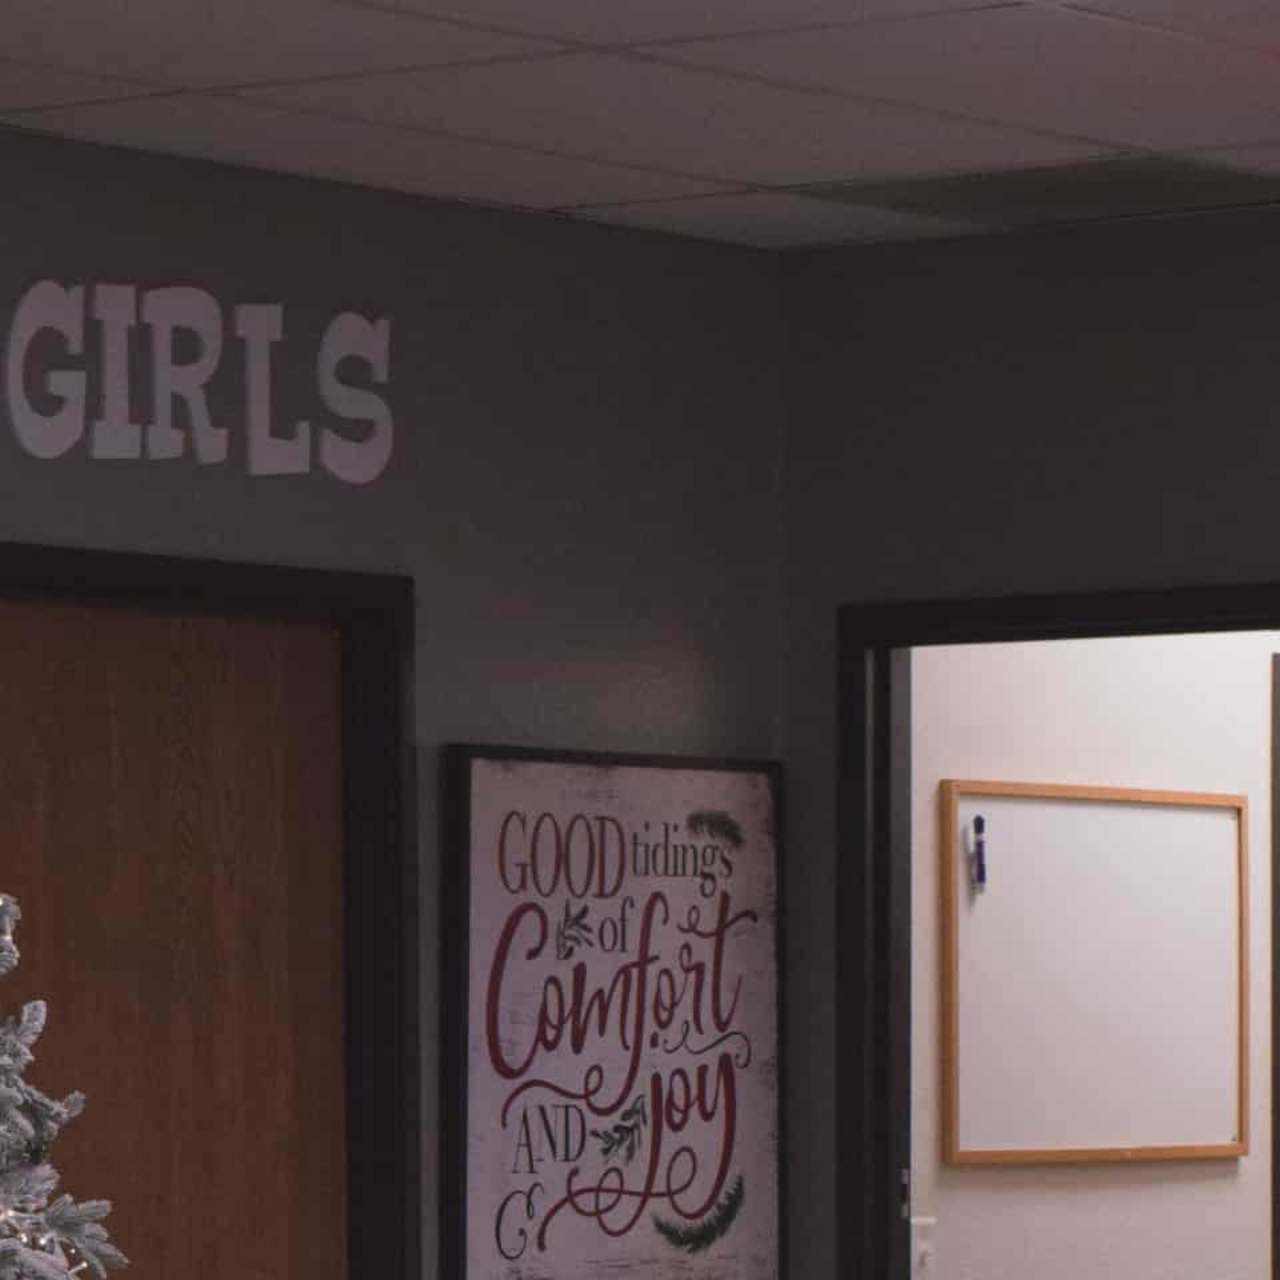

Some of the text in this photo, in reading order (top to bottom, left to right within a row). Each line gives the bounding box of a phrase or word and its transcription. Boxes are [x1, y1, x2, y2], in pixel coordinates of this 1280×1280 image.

[7, 280, 394, 484] GIRLS
[498, 810, 734, 898] GOOD tidings
[598, 897, 635, 953] of
[486, 890, 758, 1116] Comfort
[512, 1104, 587, 1174] AND
